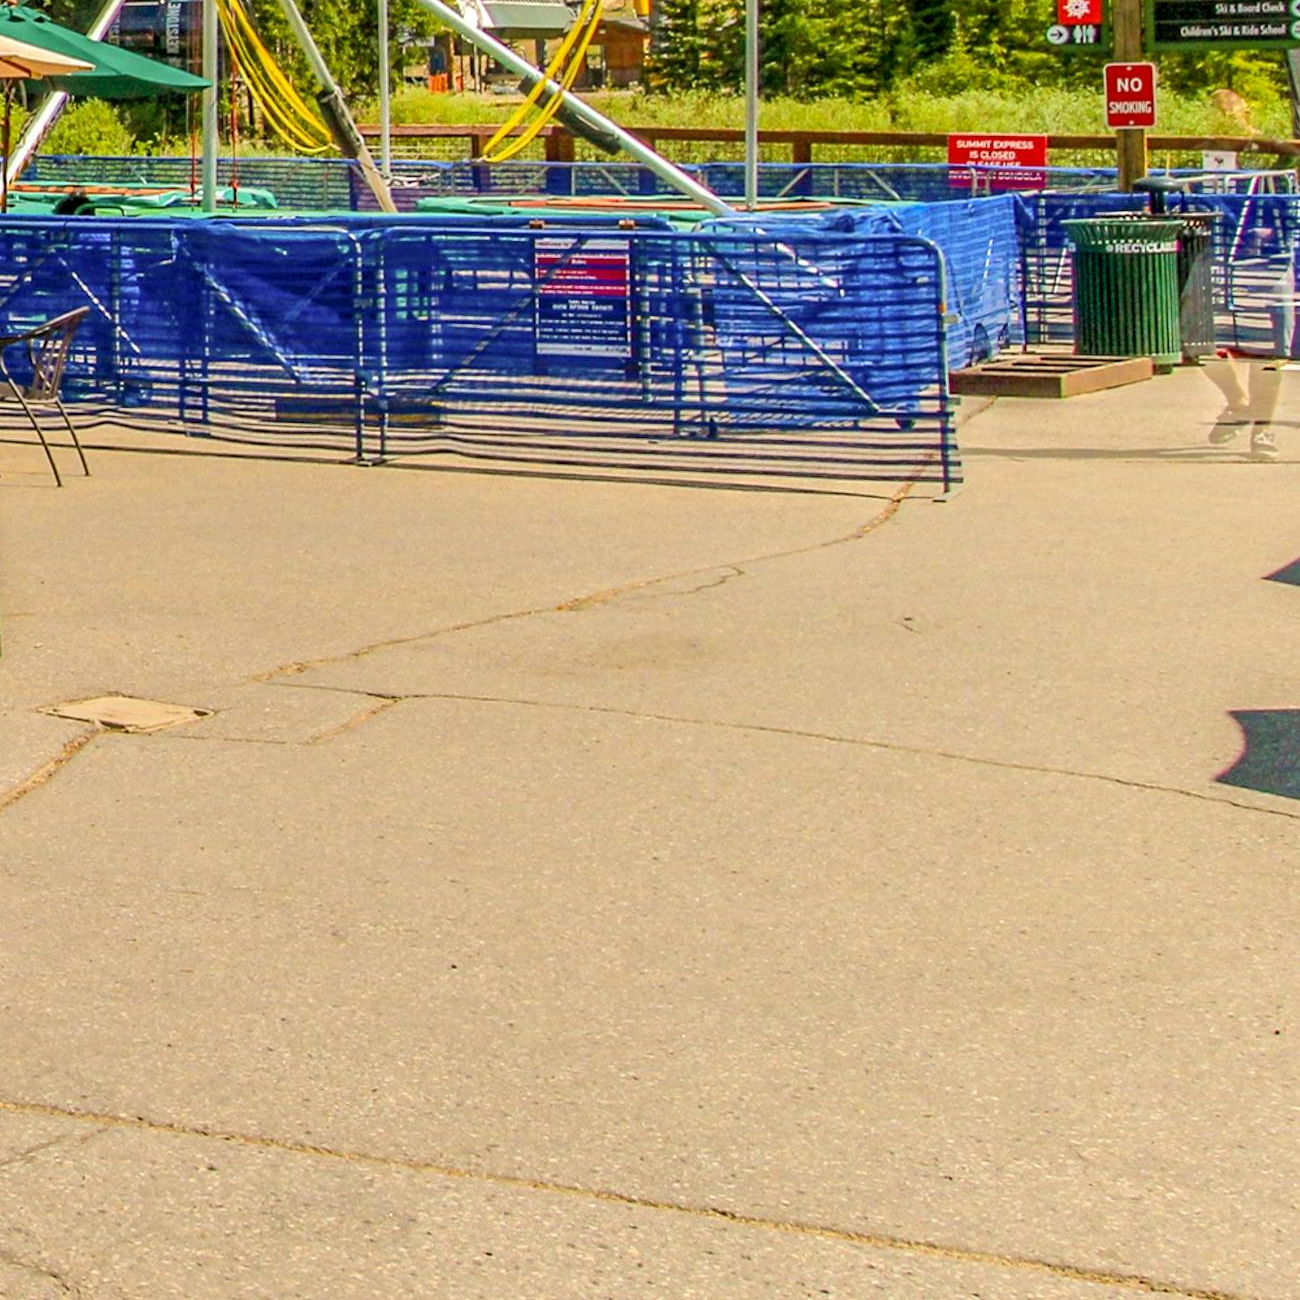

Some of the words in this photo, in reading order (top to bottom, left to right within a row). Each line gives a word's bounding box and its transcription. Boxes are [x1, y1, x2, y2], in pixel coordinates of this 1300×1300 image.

[1262, 2, 1285, 12] Check
[1260, 24, 1287, 35] School
[1116, 78, 1142, 92] NO
[1109, 101, 1152, 114] SMOKING
[956, 140, 991, 149] SUMMIT
[993, 140, 1034, 149] EXPRESS
[969, 151, 978, 159] IS
[980, 151, 1016, 160] CLOSED
